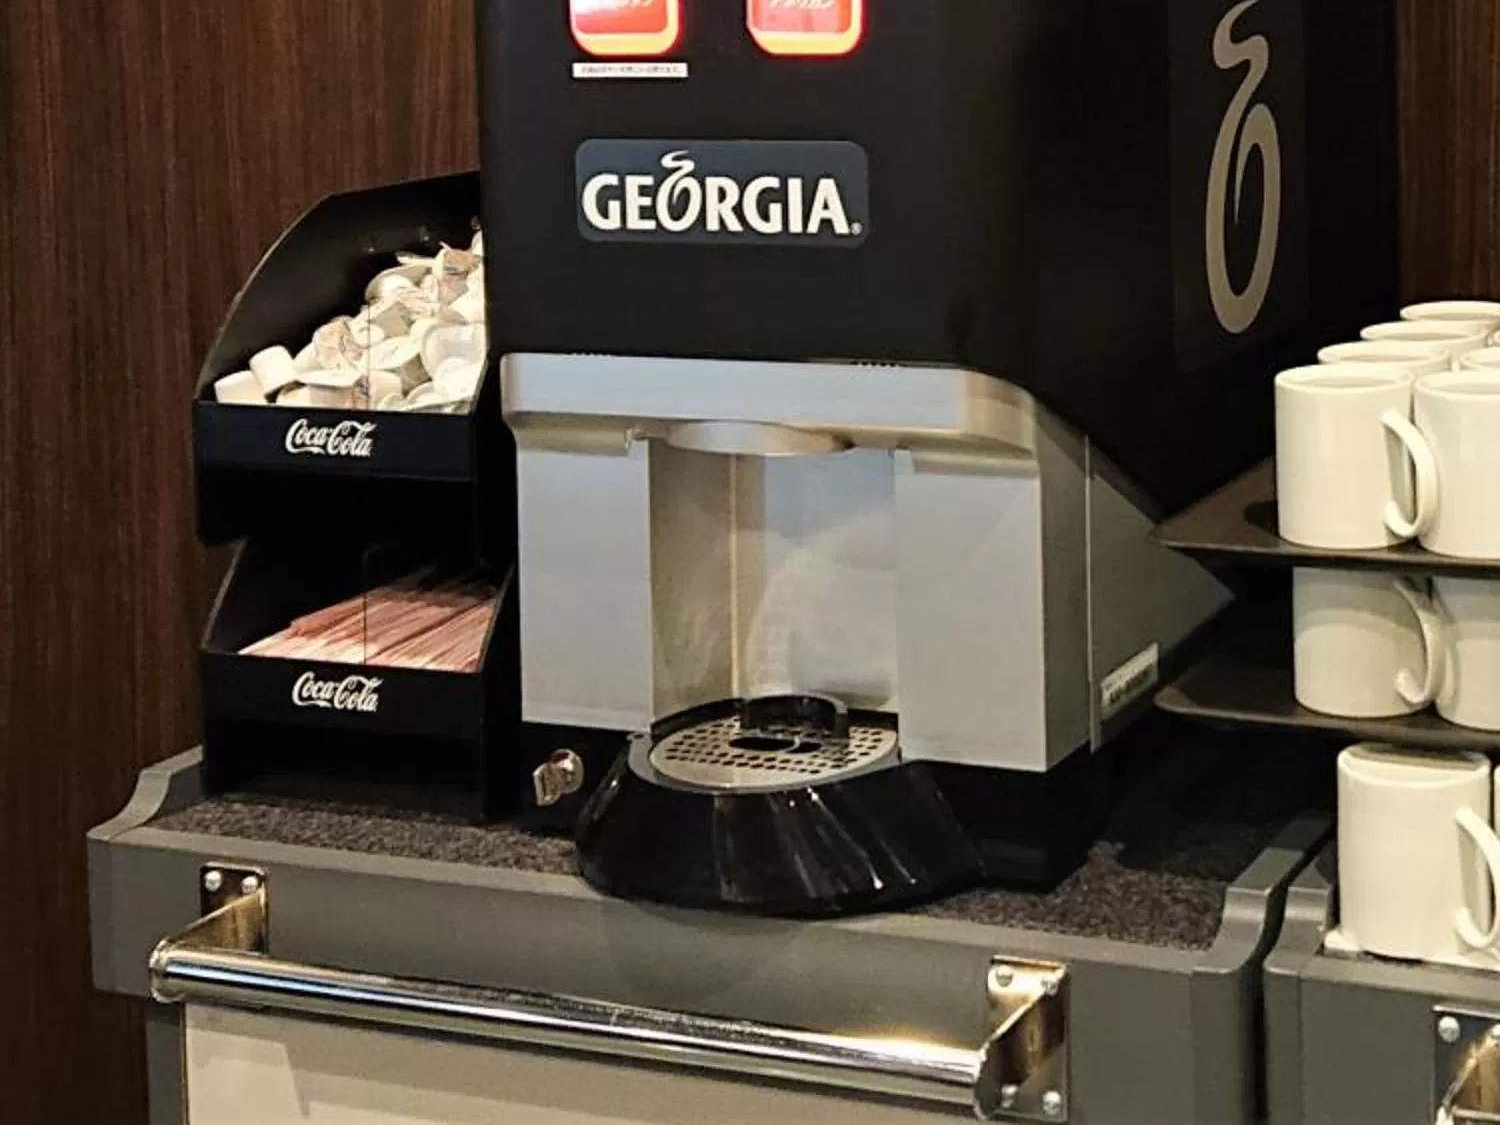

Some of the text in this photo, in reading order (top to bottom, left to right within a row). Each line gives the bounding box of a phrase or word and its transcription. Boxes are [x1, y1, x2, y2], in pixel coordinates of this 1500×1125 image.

[581, 150, 852, 236] GEORGIA
[285, 418, 377, 457] Coca-Cola
[292, 671, 384, 712] Coca-Cola
